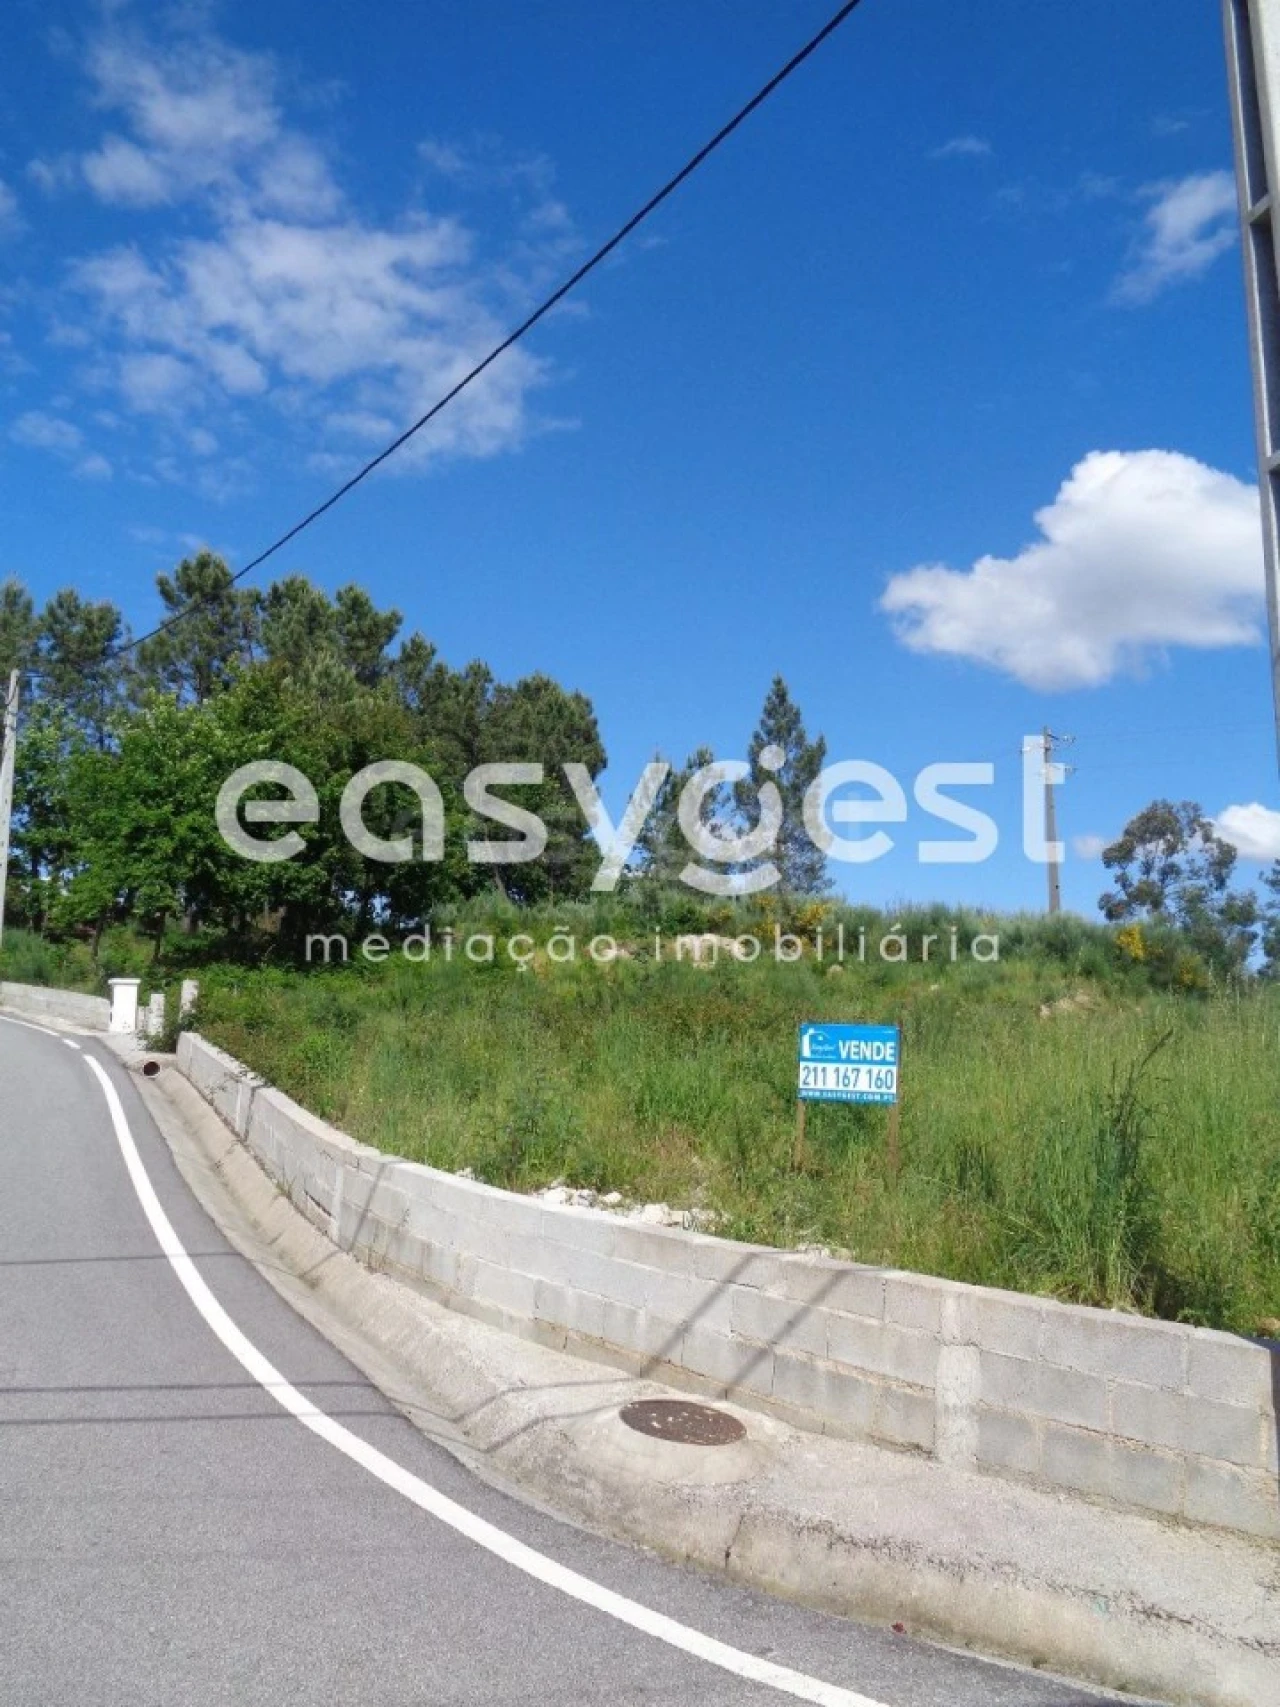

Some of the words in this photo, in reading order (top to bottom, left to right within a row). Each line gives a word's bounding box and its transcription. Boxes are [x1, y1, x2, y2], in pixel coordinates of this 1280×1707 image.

[838, 1039, 895, 1061] VENDE
[802, 1065, 827, 1087] 211
[834, 1066, 860, 1088] 167
[867, 1068, 894, 1090] 160
